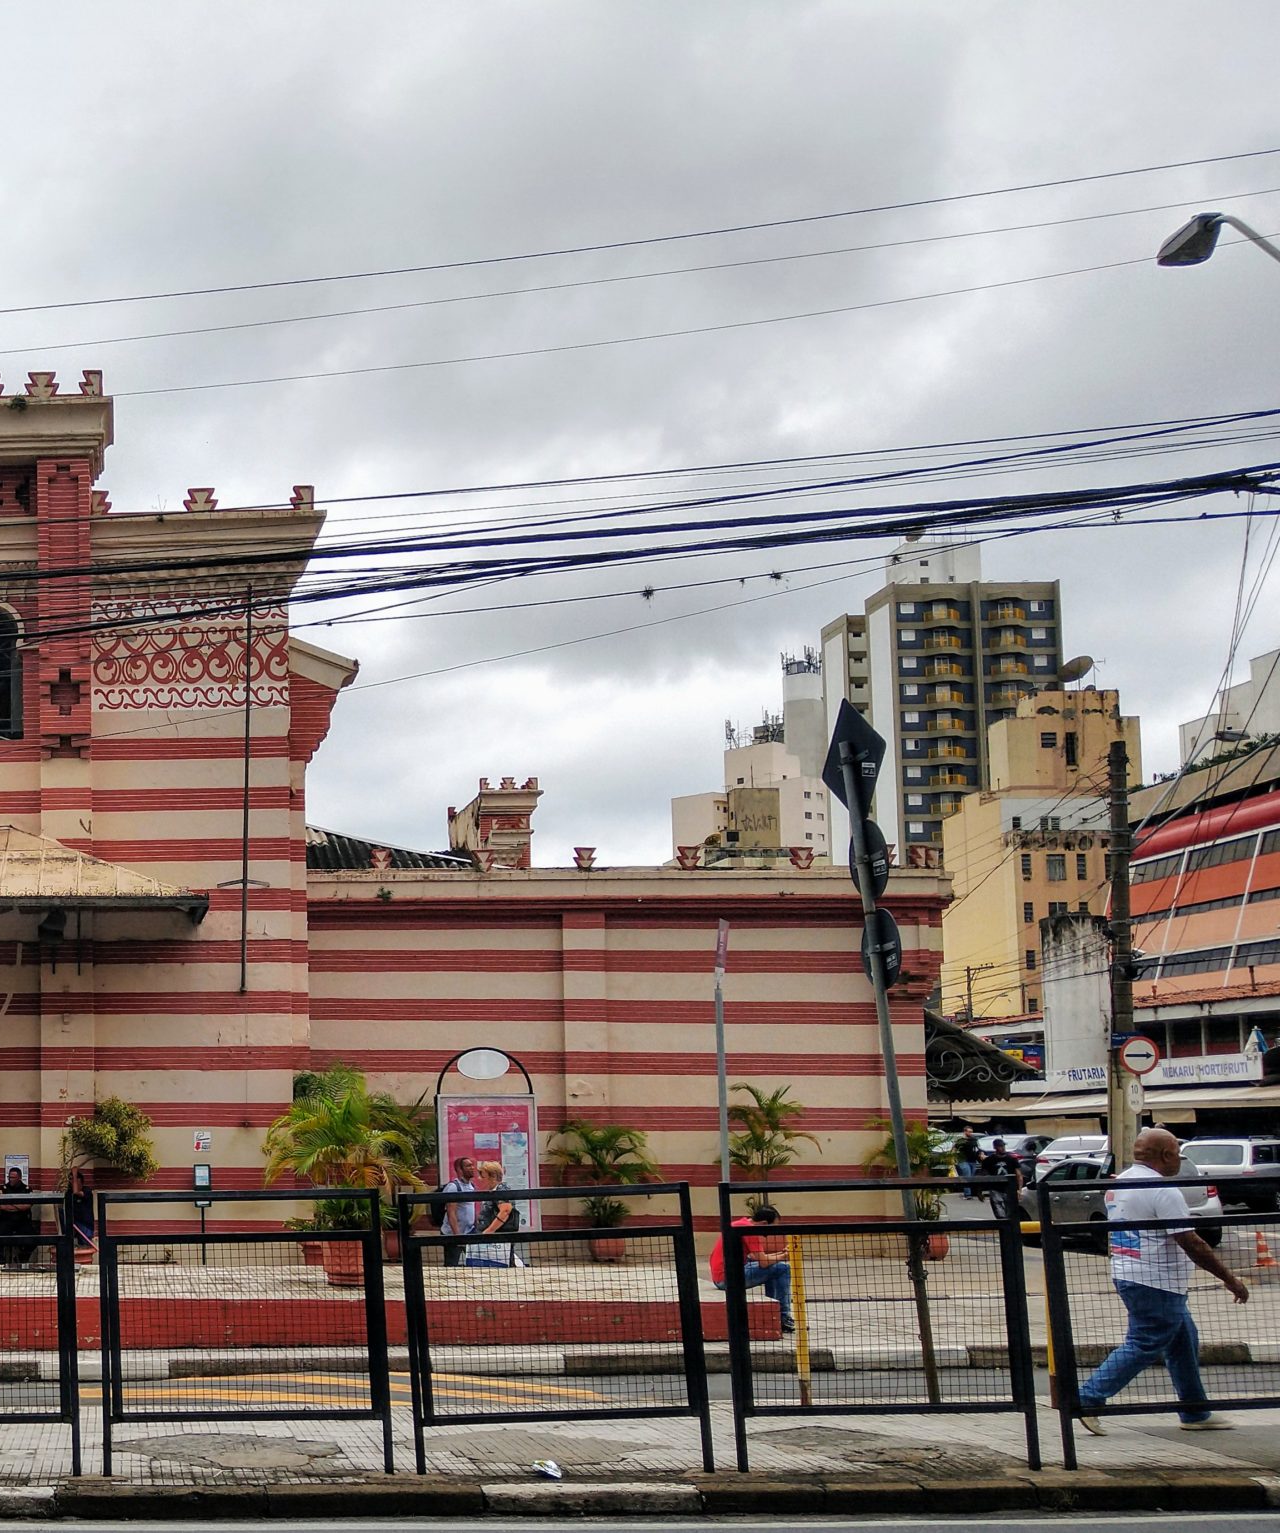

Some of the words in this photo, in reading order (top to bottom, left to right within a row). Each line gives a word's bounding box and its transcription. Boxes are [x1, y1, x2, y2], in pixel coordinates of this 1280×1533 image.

[1067, 1066, 1107, 1082] FRUTARIA
[1162, 1065, 1195, 1078] MEKARU
[1131, 1084, 1139, 1094] 10
